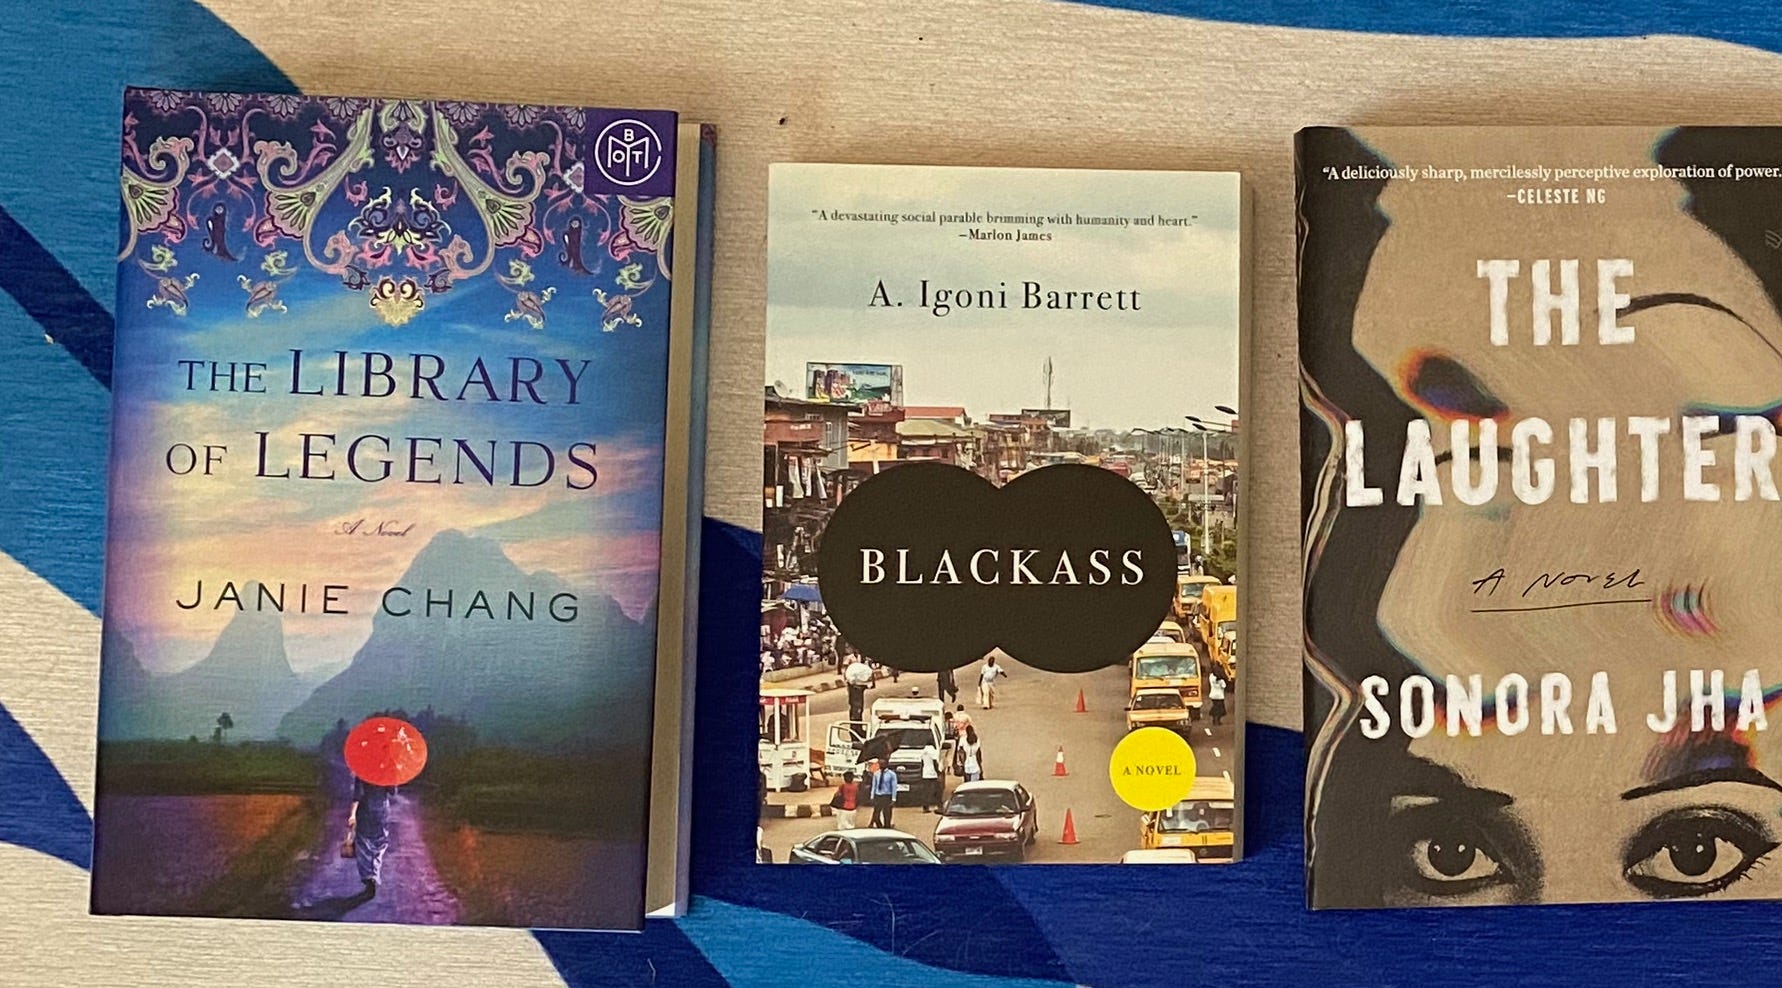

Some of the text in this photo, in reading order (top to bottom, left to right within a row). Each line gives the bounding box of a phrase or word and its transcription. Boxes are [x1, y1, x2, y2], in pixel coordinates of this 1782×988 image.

[1341, 165, 1418, 181] deliciously
[1421, 166, 1467, 181] sharp,
[1470, 166, 1551, 181] mercilessly
[1554, 165, 1630, 181] perceptive
[1633, 164, 1715, 180] exploration
[1718, 163, 1734, 178] of
[1586, 188, 1606, 204] NG
[830, 210, 899, 225] devastating
[901, 211, 936, 223] social
[939, 211, 982, 226] parable
[986, 212, 1044, 228] brimming
[1047, 213, 1073, 226] with
[1076, 214, 1130, 228] humanity
[1133, 214, 1154, 226] and
[1016, 229, 1052, 242] James
[867, 279, 1142, 318] A. Igoni Barrett
[1477, 259, 1636, 346] THE
[178, 349, 591, 405] THE LIBRARY
[165, 431, 598, 490] OF LEGENDS
[1345, 415, 1780, 507] LAUGHTER
[334, 519, 416, 538] A Novel
[860, 547, 1145, 586] BLACKASS
[1471, 568, 1506, 595] A
[176, 580, 579, 623] JANIE CHANG
[1359, 668, 1768, 740] SONORA JHA
[1122, 765, 1182, 777] A NOVEL
